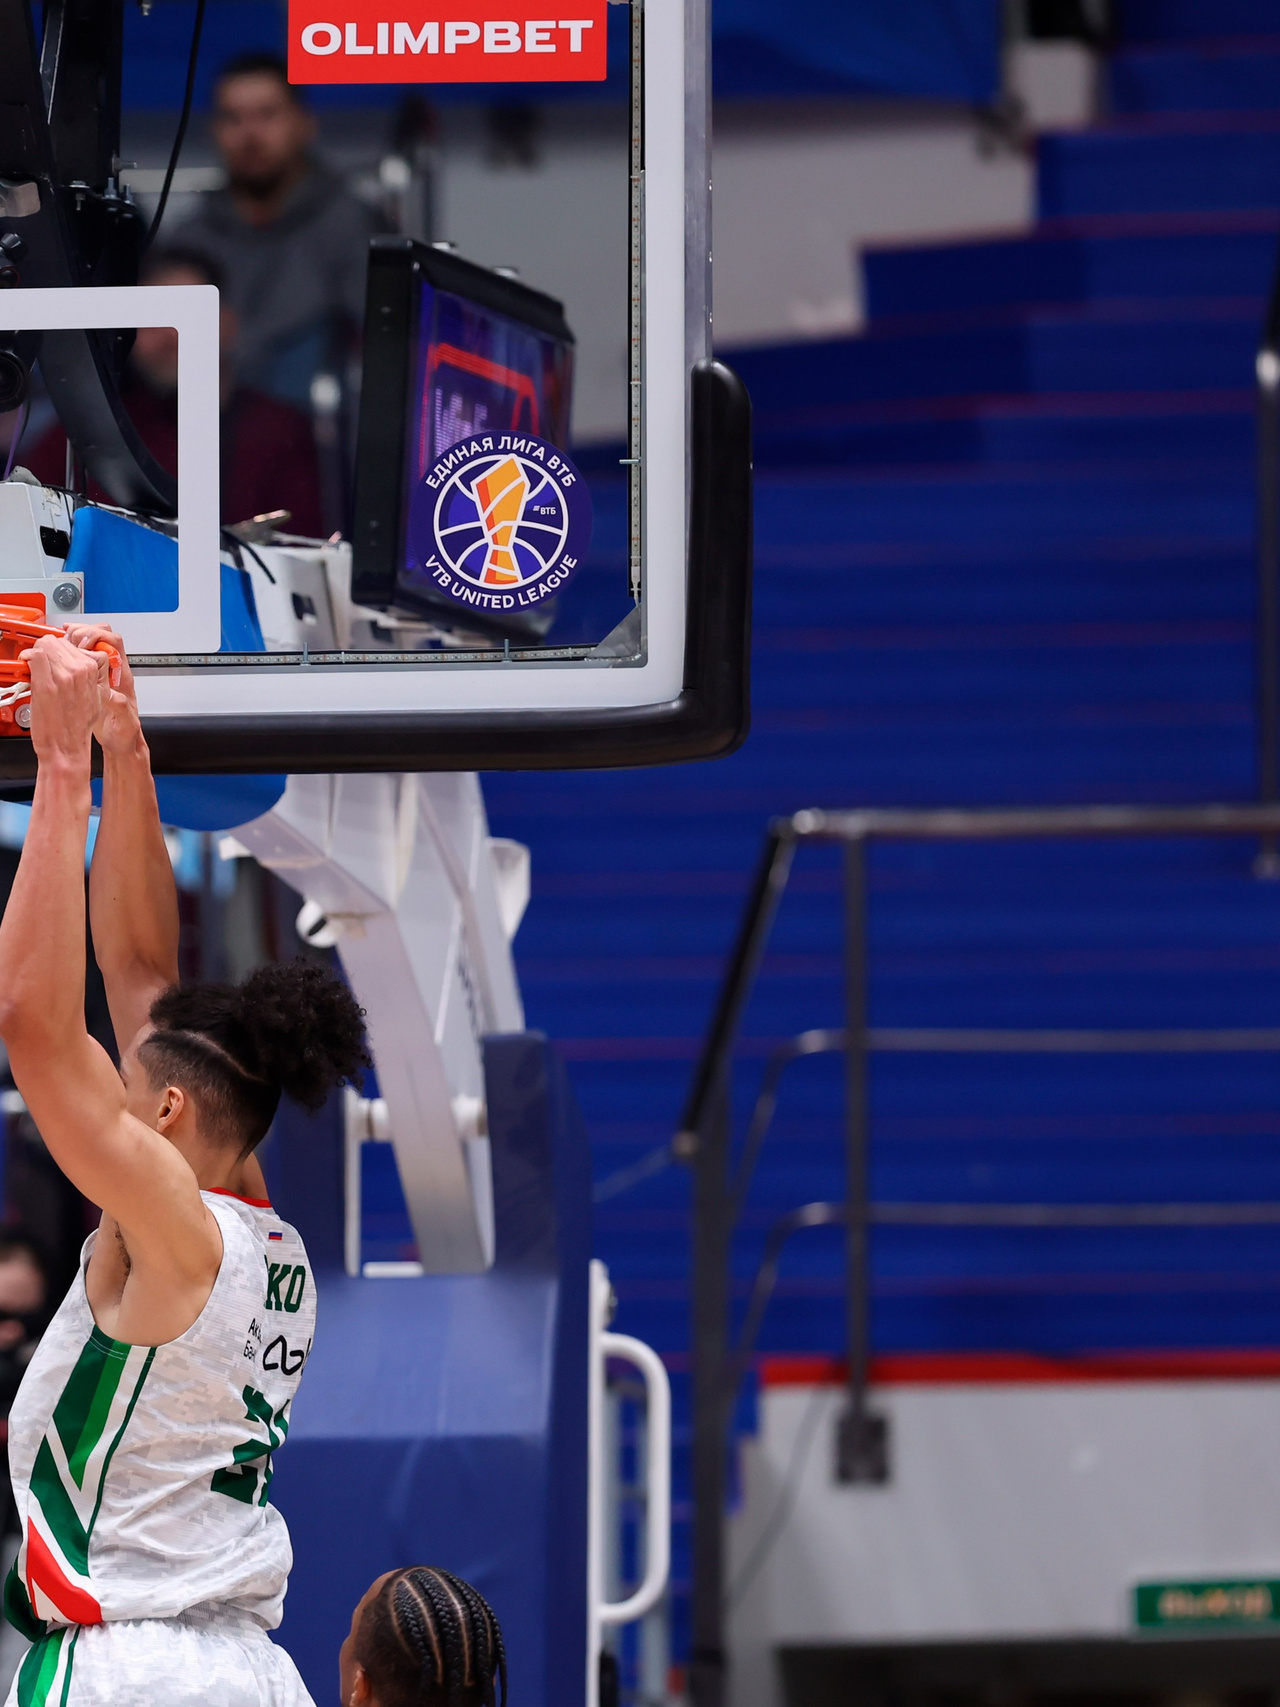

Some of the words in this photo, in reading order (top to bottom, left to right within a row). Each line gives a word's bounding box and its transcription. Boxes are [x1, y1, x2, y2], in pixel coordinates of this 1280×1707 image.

[301, 20, 594, 56] OLIMPBET
[425, 437, 494, 489] ЕДИНАЯ
[498, 436, 546, 461] ЛИГА
[547, 455, 577, 487] ВТБ
[540, 507, 556, 515] ВТБ
[425, 554, 452, 587] VTB
[451, 582, 515, 608] UNITED
[518, 554, 577, 606] LEAGUE
[263, 1254, 306, 1313] KO
